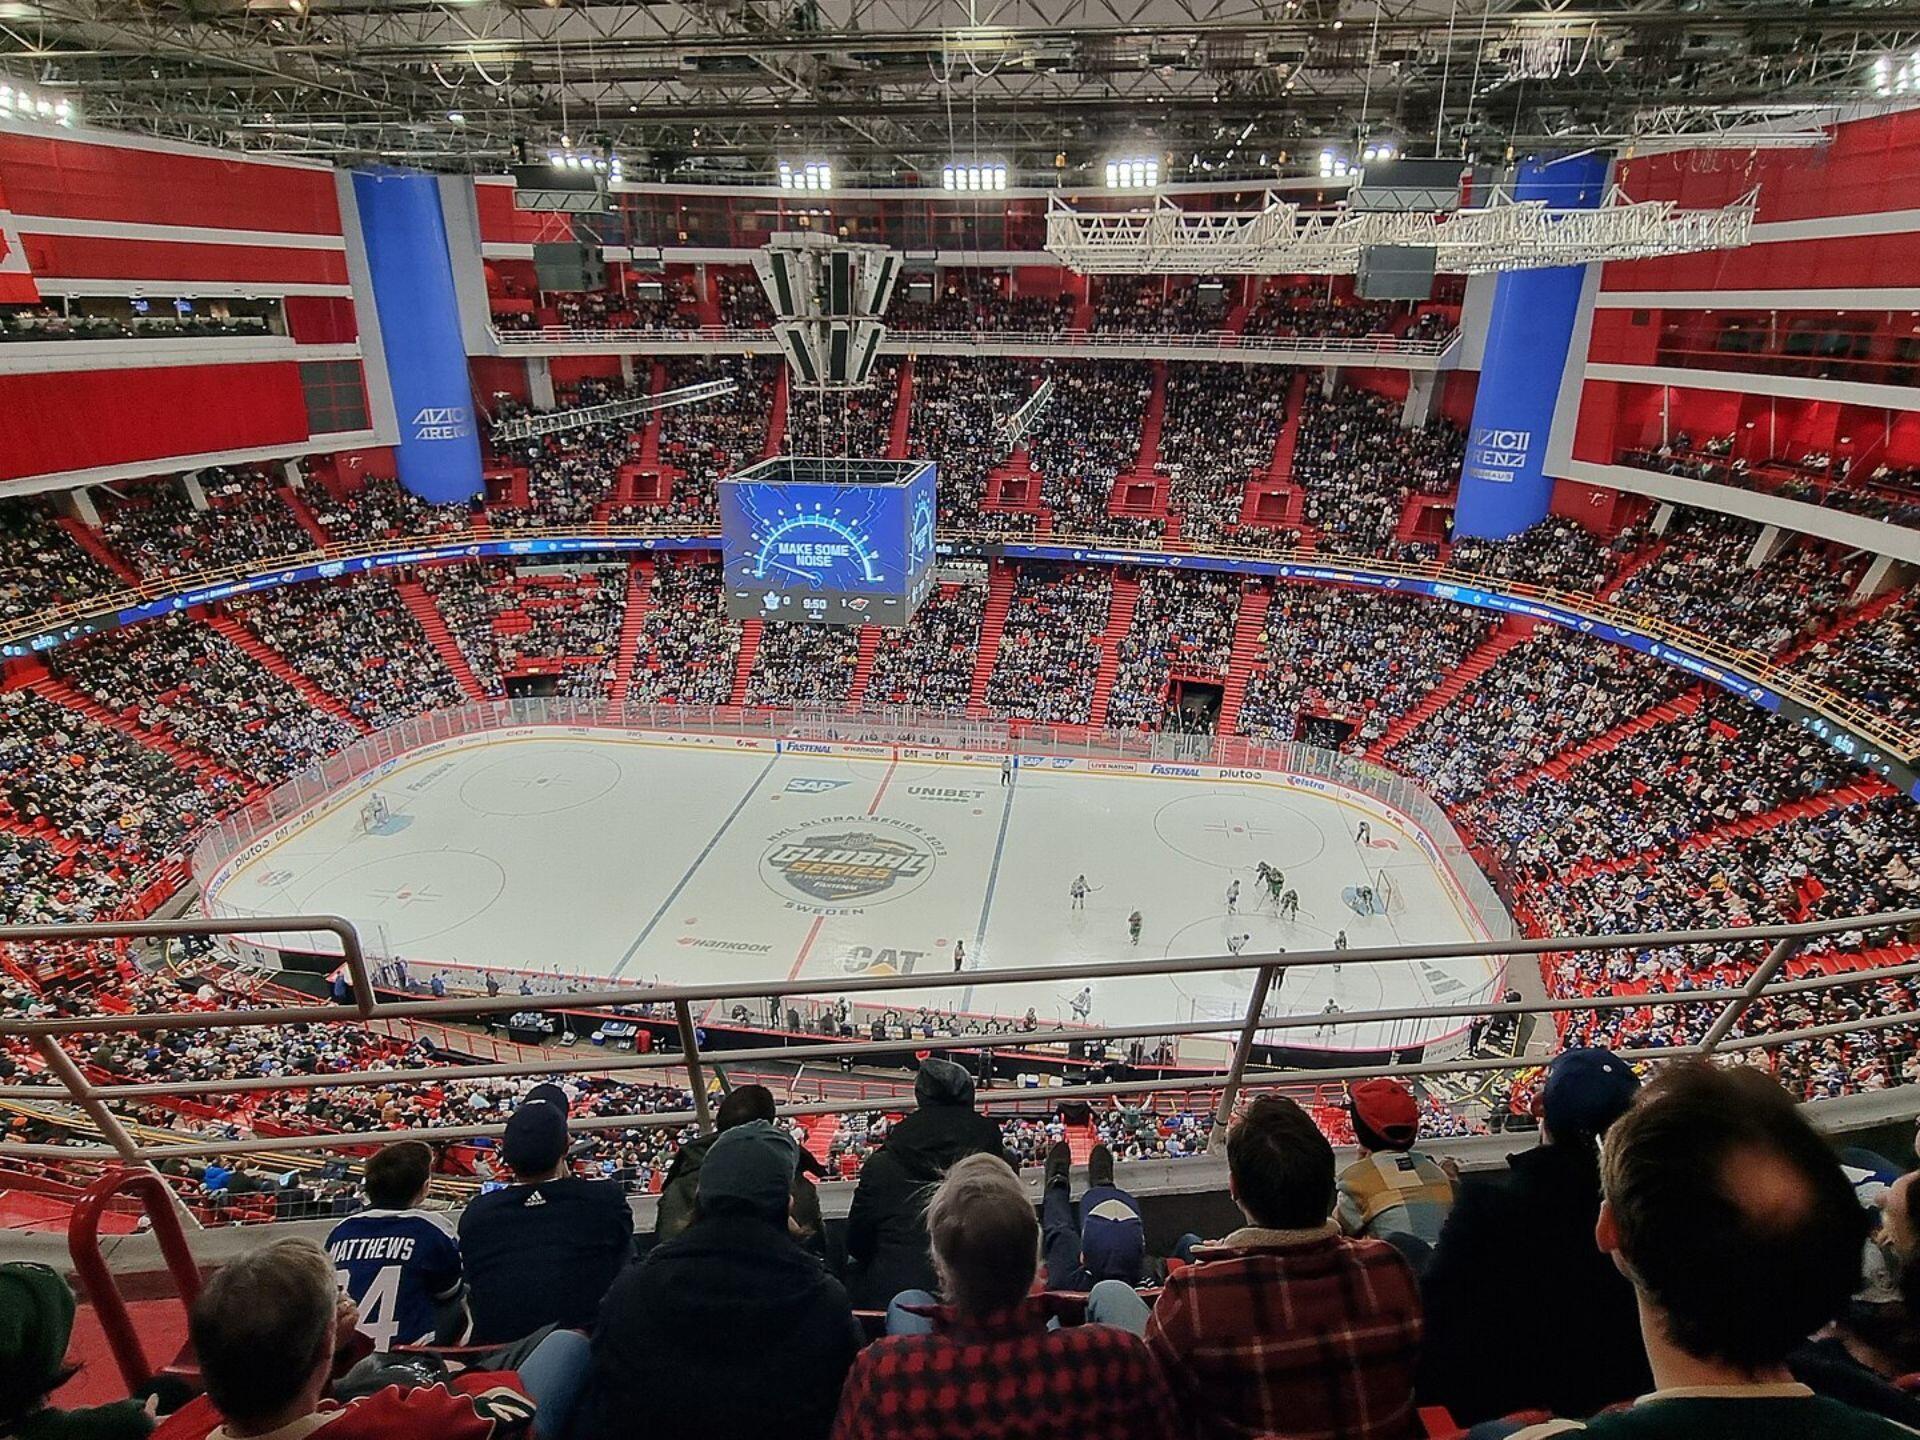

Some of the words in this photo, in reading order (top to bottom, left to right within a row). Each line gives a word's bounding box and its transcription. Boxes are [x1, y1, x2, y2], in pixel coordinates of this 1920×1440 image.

[778, 543, 813, 556] MAKE
[814, 544, 850, 557] SOME
[796, 556, 833, 567] NOISE
[783, 596, 791, 605] 0
[786, 741, 833, 754] FASTENAL
[1023, 755, 1042, 766] SAP
[1052, 758, 1071, 768] SAP
[1108, 763, 1135, 771] NATION
[1150, 764, 1201, 777] FASTENAL
[1288, 775, 1325, 790] Telstra
[907, 786, 985, 799] UNIBET
[800, 815, 866, 827] GLOBAL
[769, 845, 930, 875] GLOBAL
[784, 861, 893, 880] SERIES
[783, 901, 865, 916] SWEDEN
[844, 946, 924, 975] CAT
[335, 1264, 402, 1353] 4
